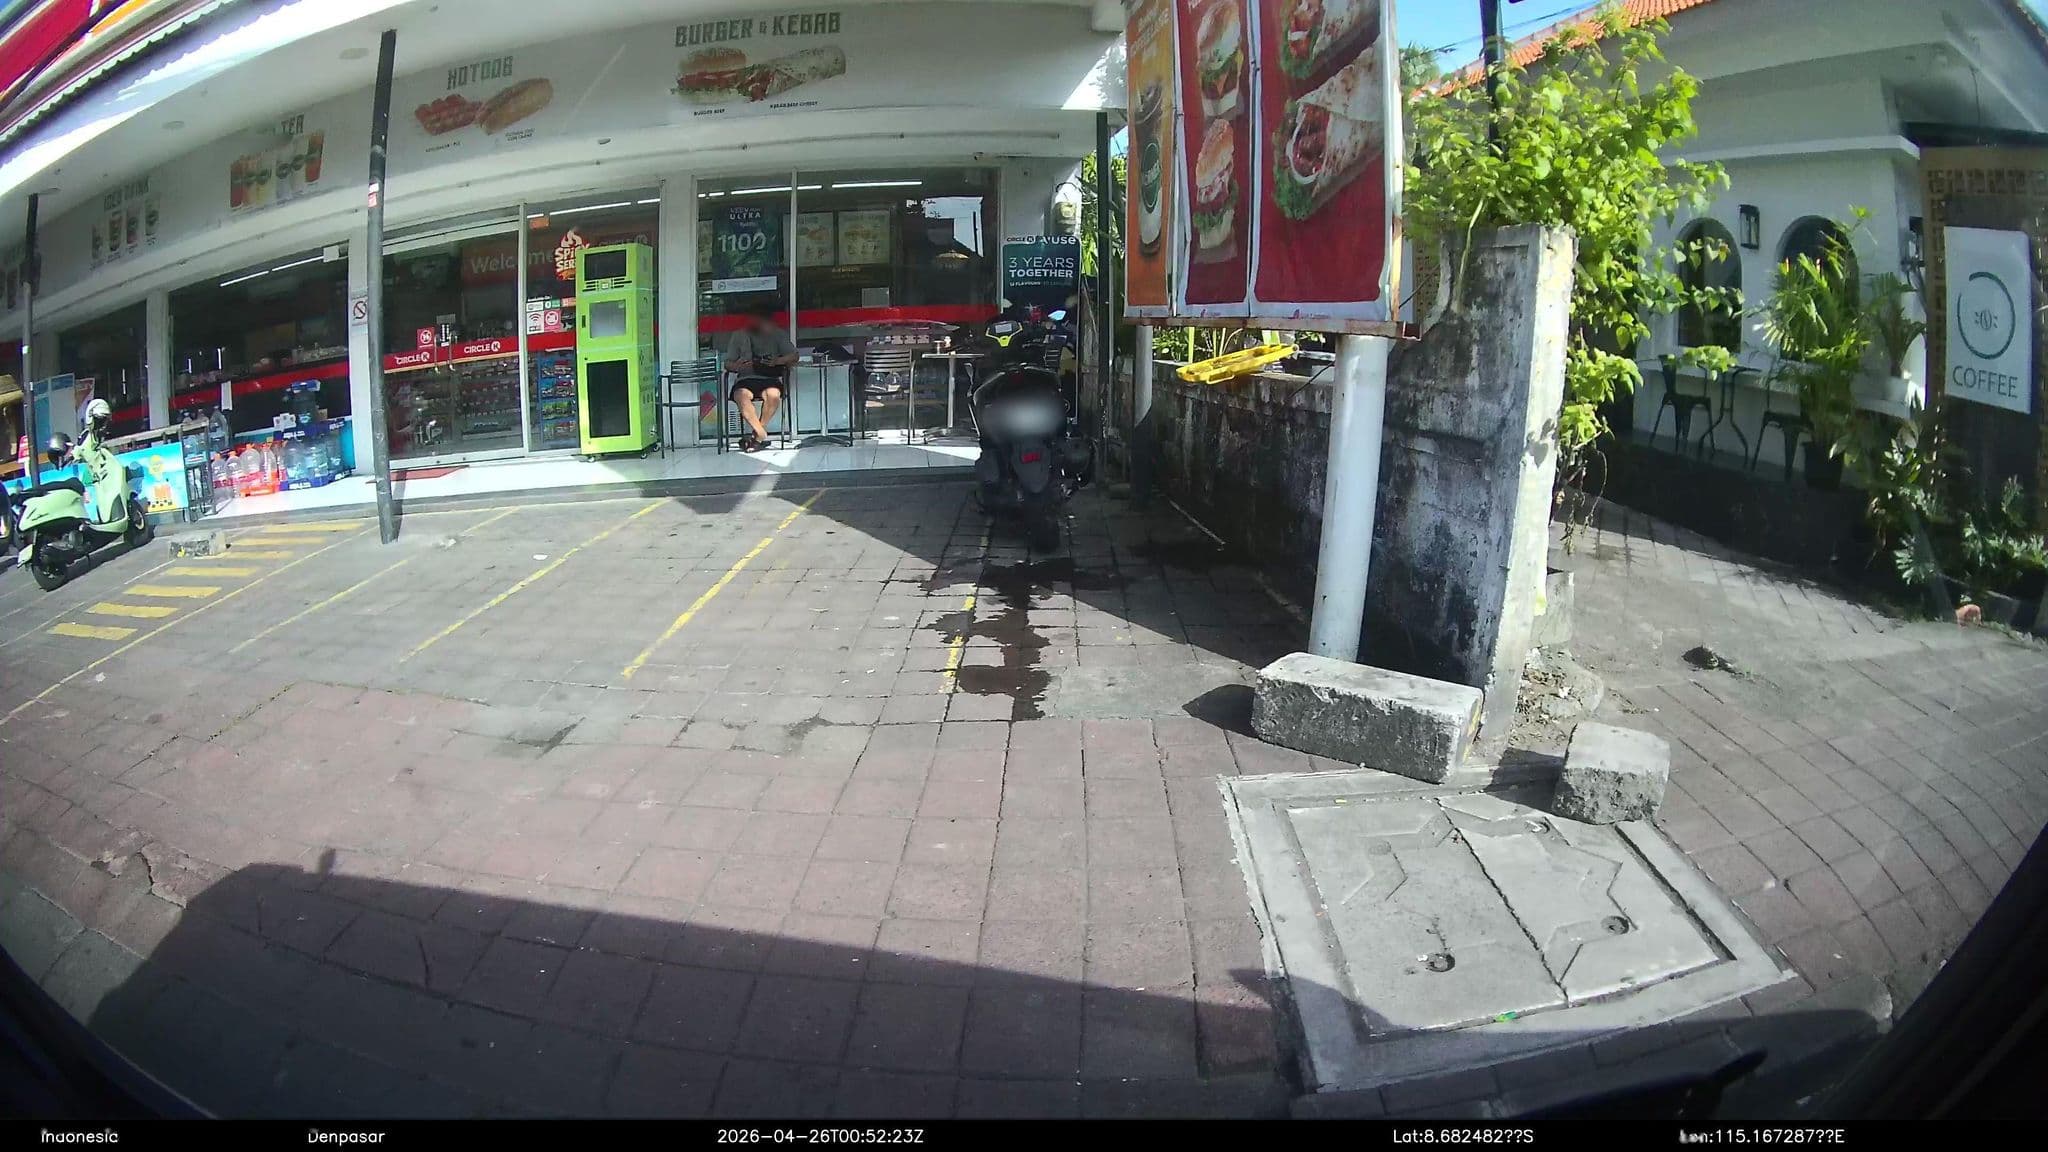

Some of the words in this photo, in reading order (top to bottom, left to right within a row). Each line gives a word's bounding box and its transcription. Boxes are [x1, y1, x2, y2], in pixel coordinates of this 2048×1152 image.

[675, 18, 753, 48] BURGER
[772, 12, 841, 37] KEBAB
[470, 249, 555, 274] Welcme
[1009, 257, 1018, 268] 3
[1023, 256, 1075, 269] YEARS
[1009, 268, 1074, 278] TOGETHER
[464, 343, 490, 354] CIRCLE
[491, 341, 501, 352] K
[396, 354, 420, 365] CIRCLE
[420, 351, 430, 362] K
[1952, 365, 2018, 398] COFFEE
